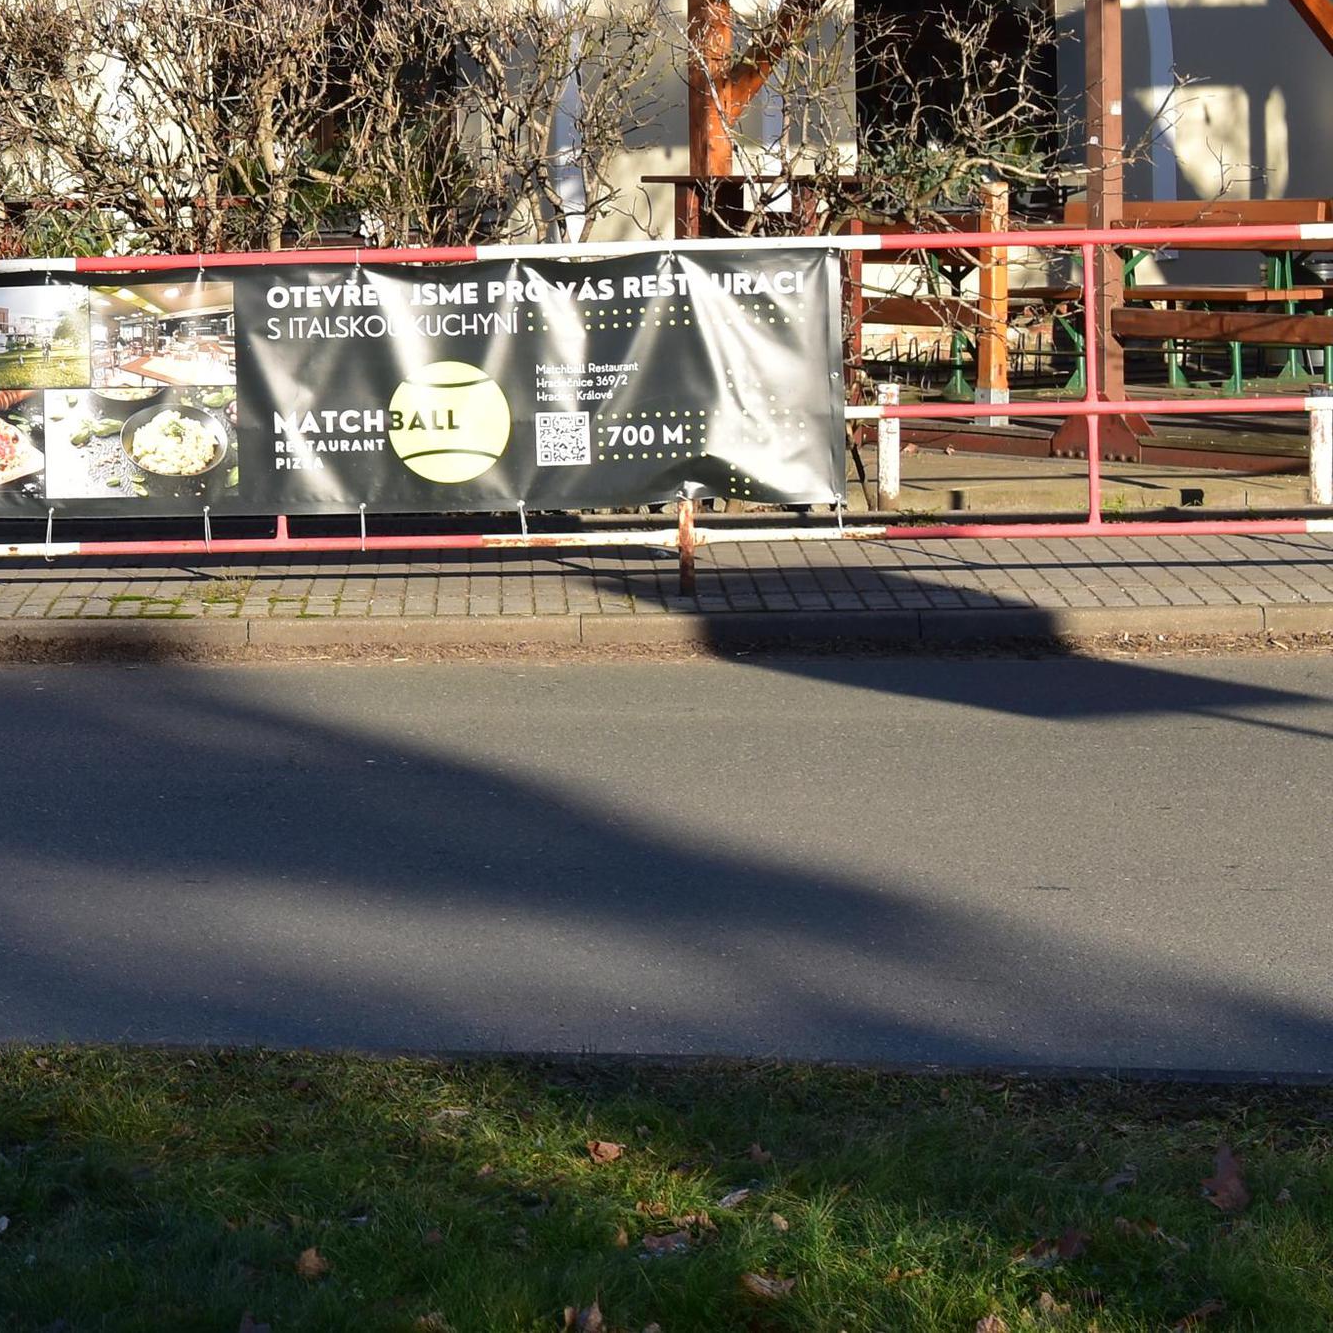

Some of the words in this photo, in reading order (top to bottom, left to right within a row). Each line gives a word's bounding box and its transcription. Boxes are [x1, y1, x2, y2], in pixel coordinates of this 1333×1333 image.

[266, 279, 400, 308] OTEVŘE
[410, 281, 479, 307] JSME
[622, 271, 804, 299] RESTURACI
[267, 318, 281, 339] S
[288, 315, 403, 339] ITALSKOU
[412, 307, 519, 337] KUCHYNÍ
[588, 362, 639, 374] Restaurant
[596, 375, 628, 389] 369/2
[576, 389, 613, 401] Králové
[606, 424, 655, 446] 700
[662, 424, 683, 445] M
[276, 456, 325, 470] PIZA
